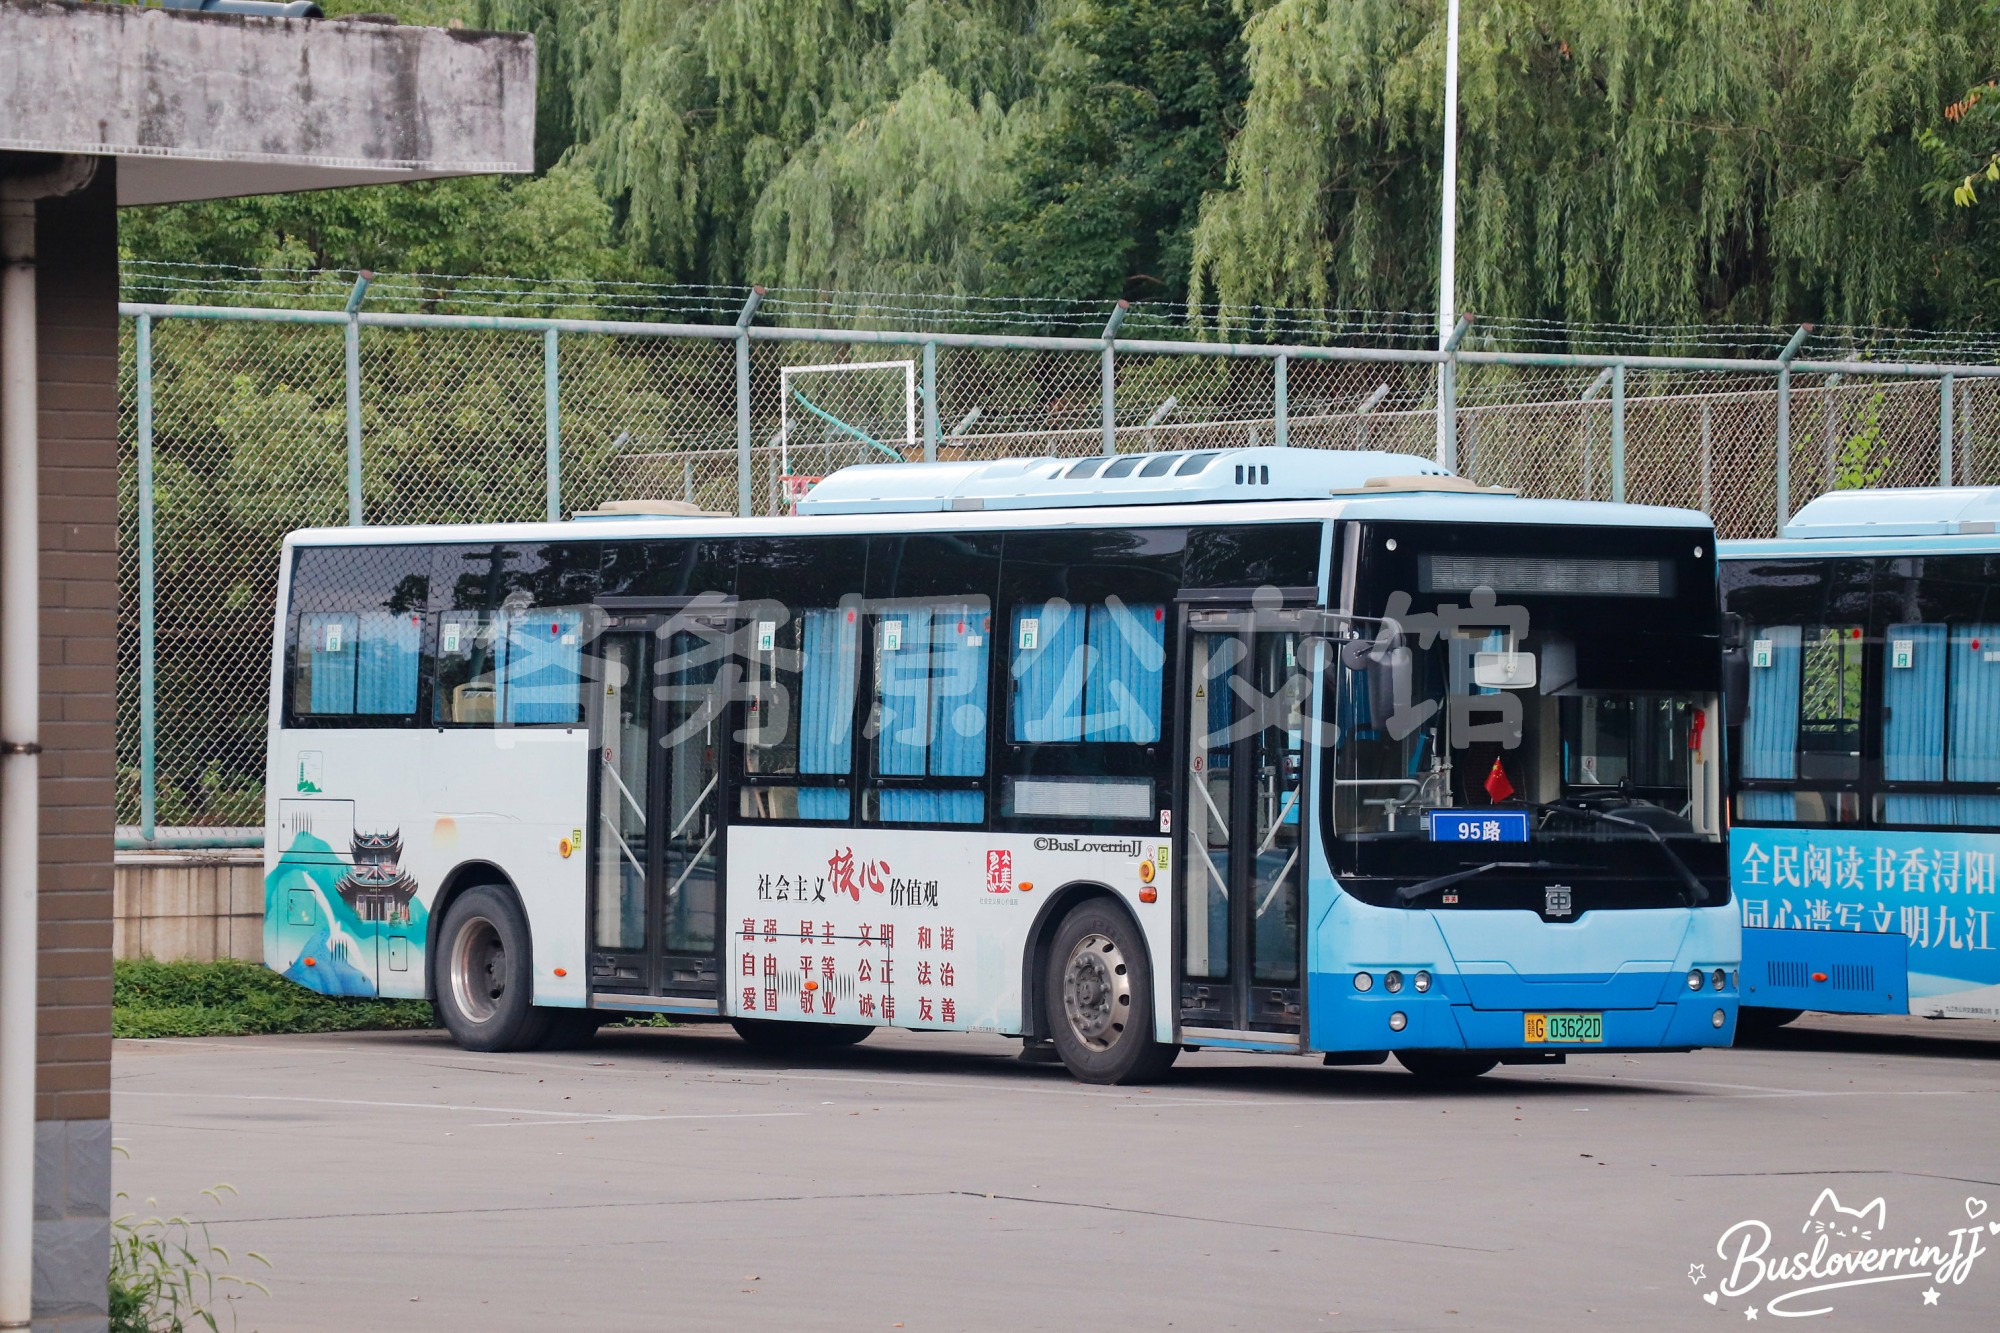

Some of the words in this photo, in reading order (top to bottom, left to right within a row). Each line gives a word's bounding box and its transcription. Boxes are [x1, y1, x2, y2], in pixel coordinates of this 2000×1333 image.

[1458, 820, 1501, 841] 95路
[757, 846, 939, 907] 社会主义核心价值观
[1741, 842, 1996, 895] 全民阅读书香浔阳
[742, 917, 778, 943] 富强
[800, 919, 836, 945] 民主
[858, 922, 895, 949] 文明
[917, 925, 955, 951] 和谐
[742, 951, 778, 977] 自由
[800, 955, 836, 980] 平等
[858, 958, 895, 984] 公正
[917, 961, 955, 987] 法治
[742, 986, 778, 1012] 爱国
[800, 990, 836, 1015] 敬业
[858, 993, 896, 1019] 诚信
[917, 996, 957, 1023] 友善
